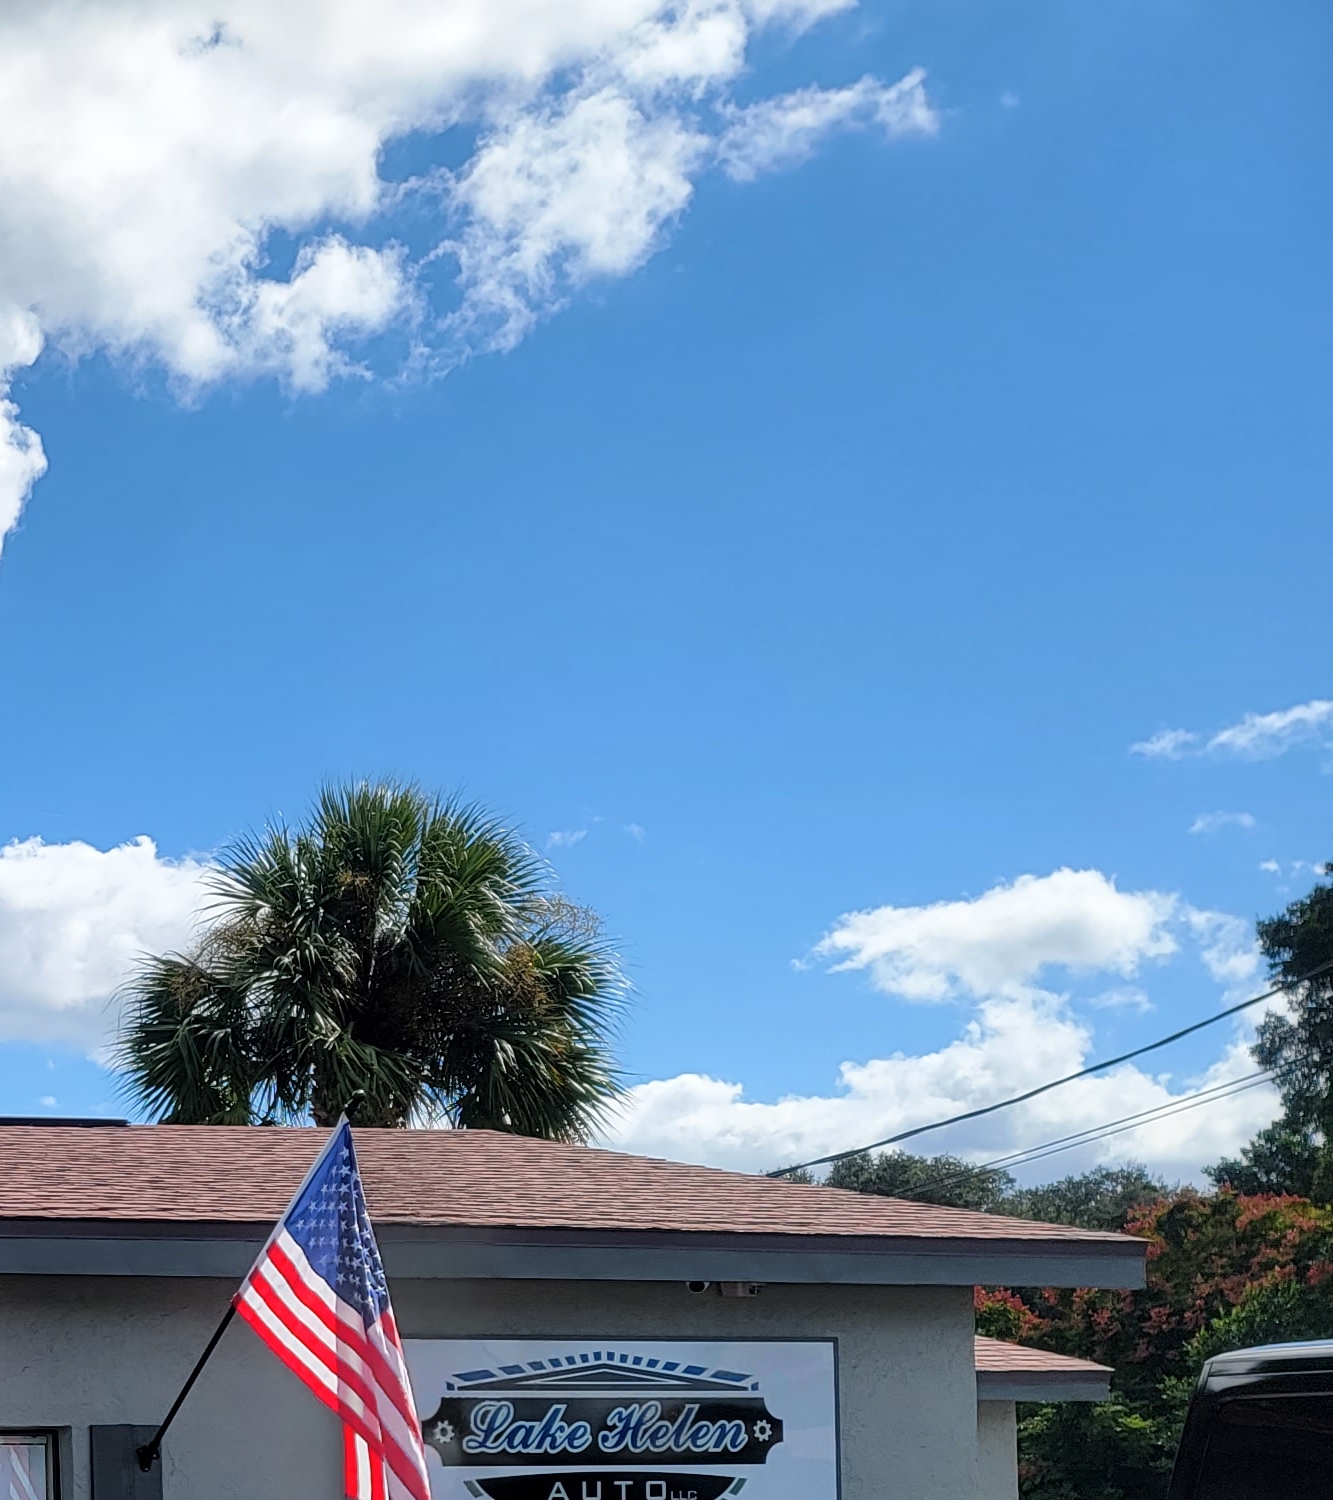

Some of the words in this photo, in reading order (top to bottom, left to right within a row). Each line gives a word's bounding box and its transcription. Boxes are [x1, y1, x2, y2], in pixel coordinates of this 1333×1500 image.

[462, 1399, 593, 1455] Lake
[597, 1400, 748, 1454] Helen
[547, 1480, 667, 1500] AUTO
[670, 1490, 698, 1500] LLC
